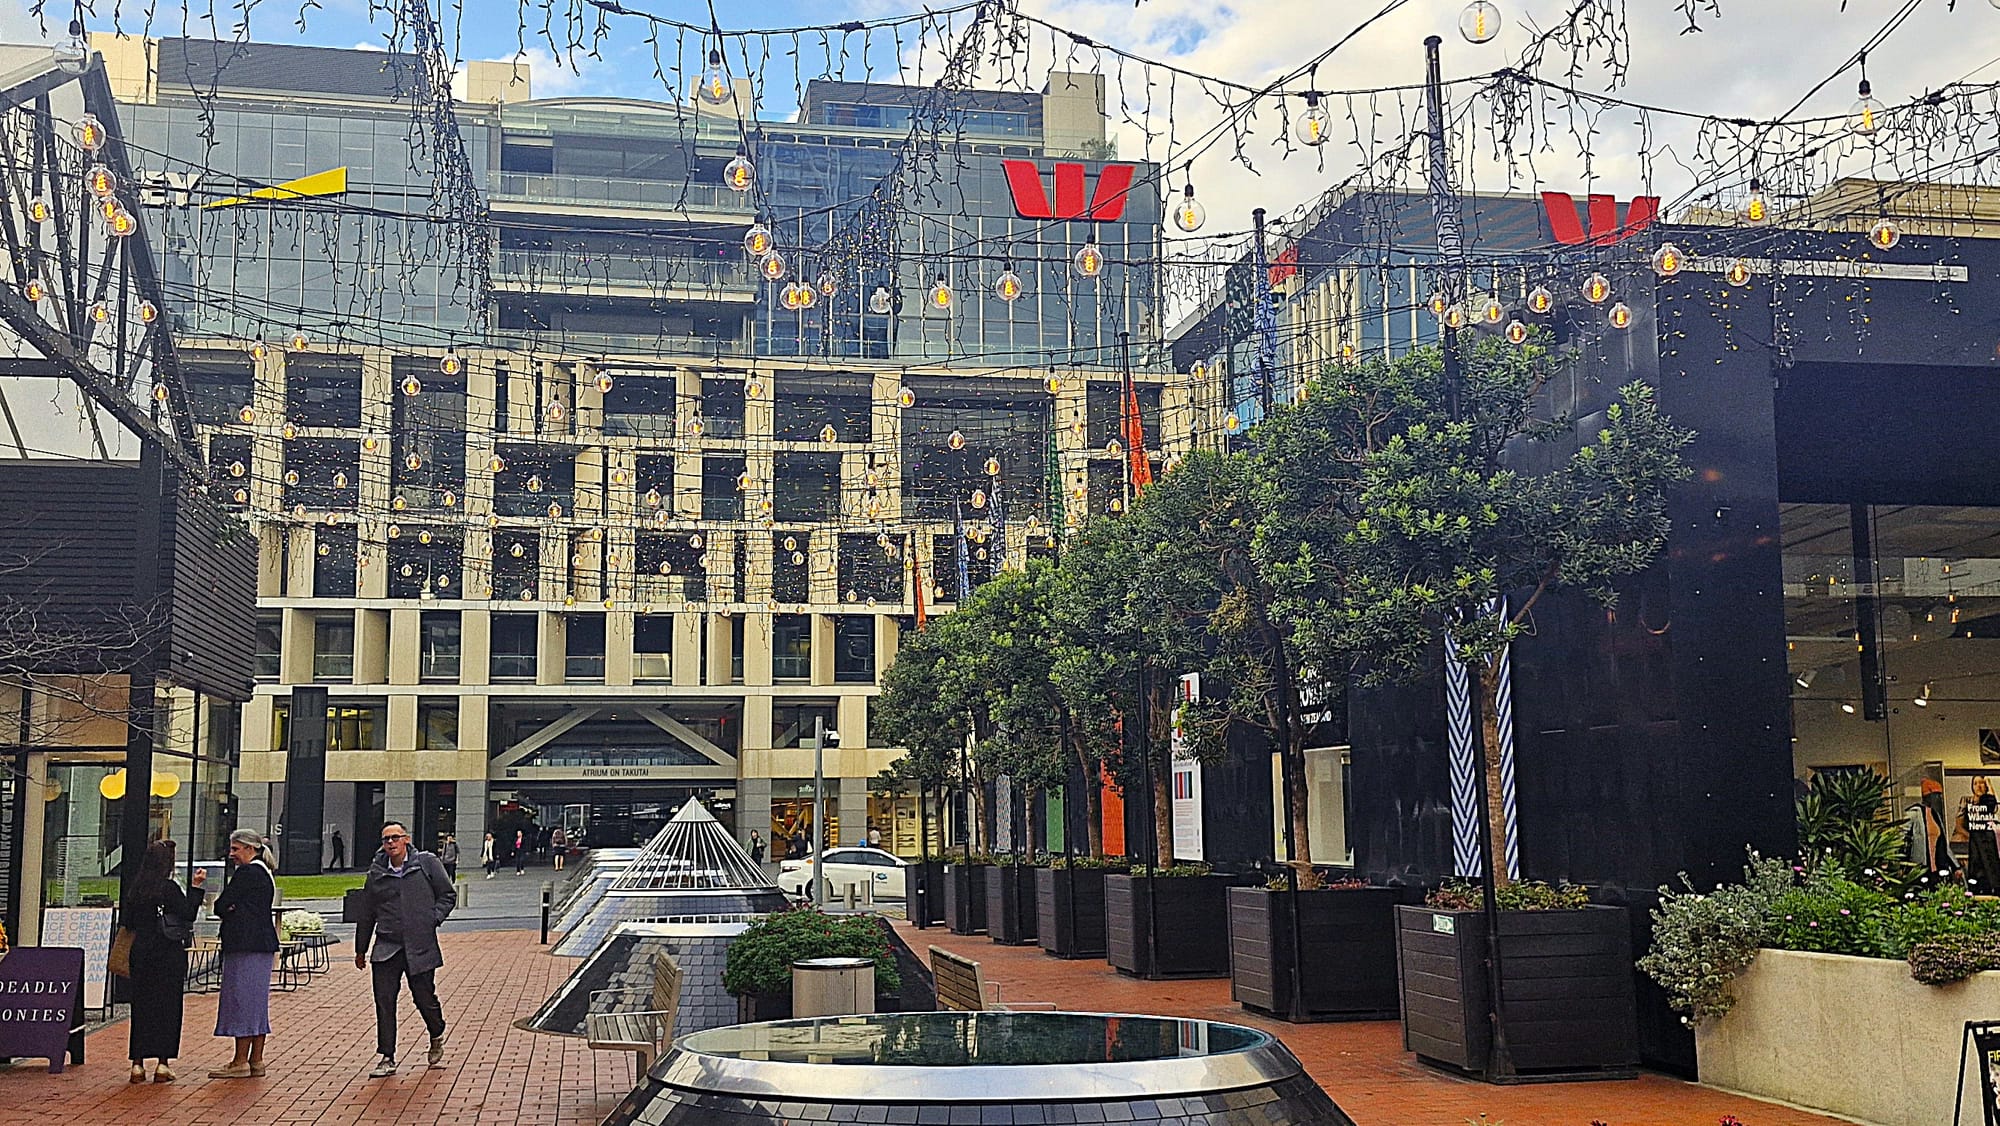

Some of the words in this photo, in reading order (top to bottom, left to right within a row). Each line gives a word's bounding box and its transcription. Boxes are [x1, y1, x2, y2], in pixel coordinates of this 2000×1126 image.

[141, 170, 202, 206] EY
[582, 768, 608, 776] ATRIUM
[610, 768, 620, 777] ON
[622, 768, 649, 777] TAKUTAI
[1967, 803, 1987, 812] From
[1968, 822, 1986, 830] New
[47, 911, 66, 921] ICE
[71, 911, 111, 921] CREAM
[45, 922, 65, 931] ICE
[69, 922, 109, 931] CREAM
[44, 932, 65, 941] ICE
[68, 932, 108, 941] CREAM
